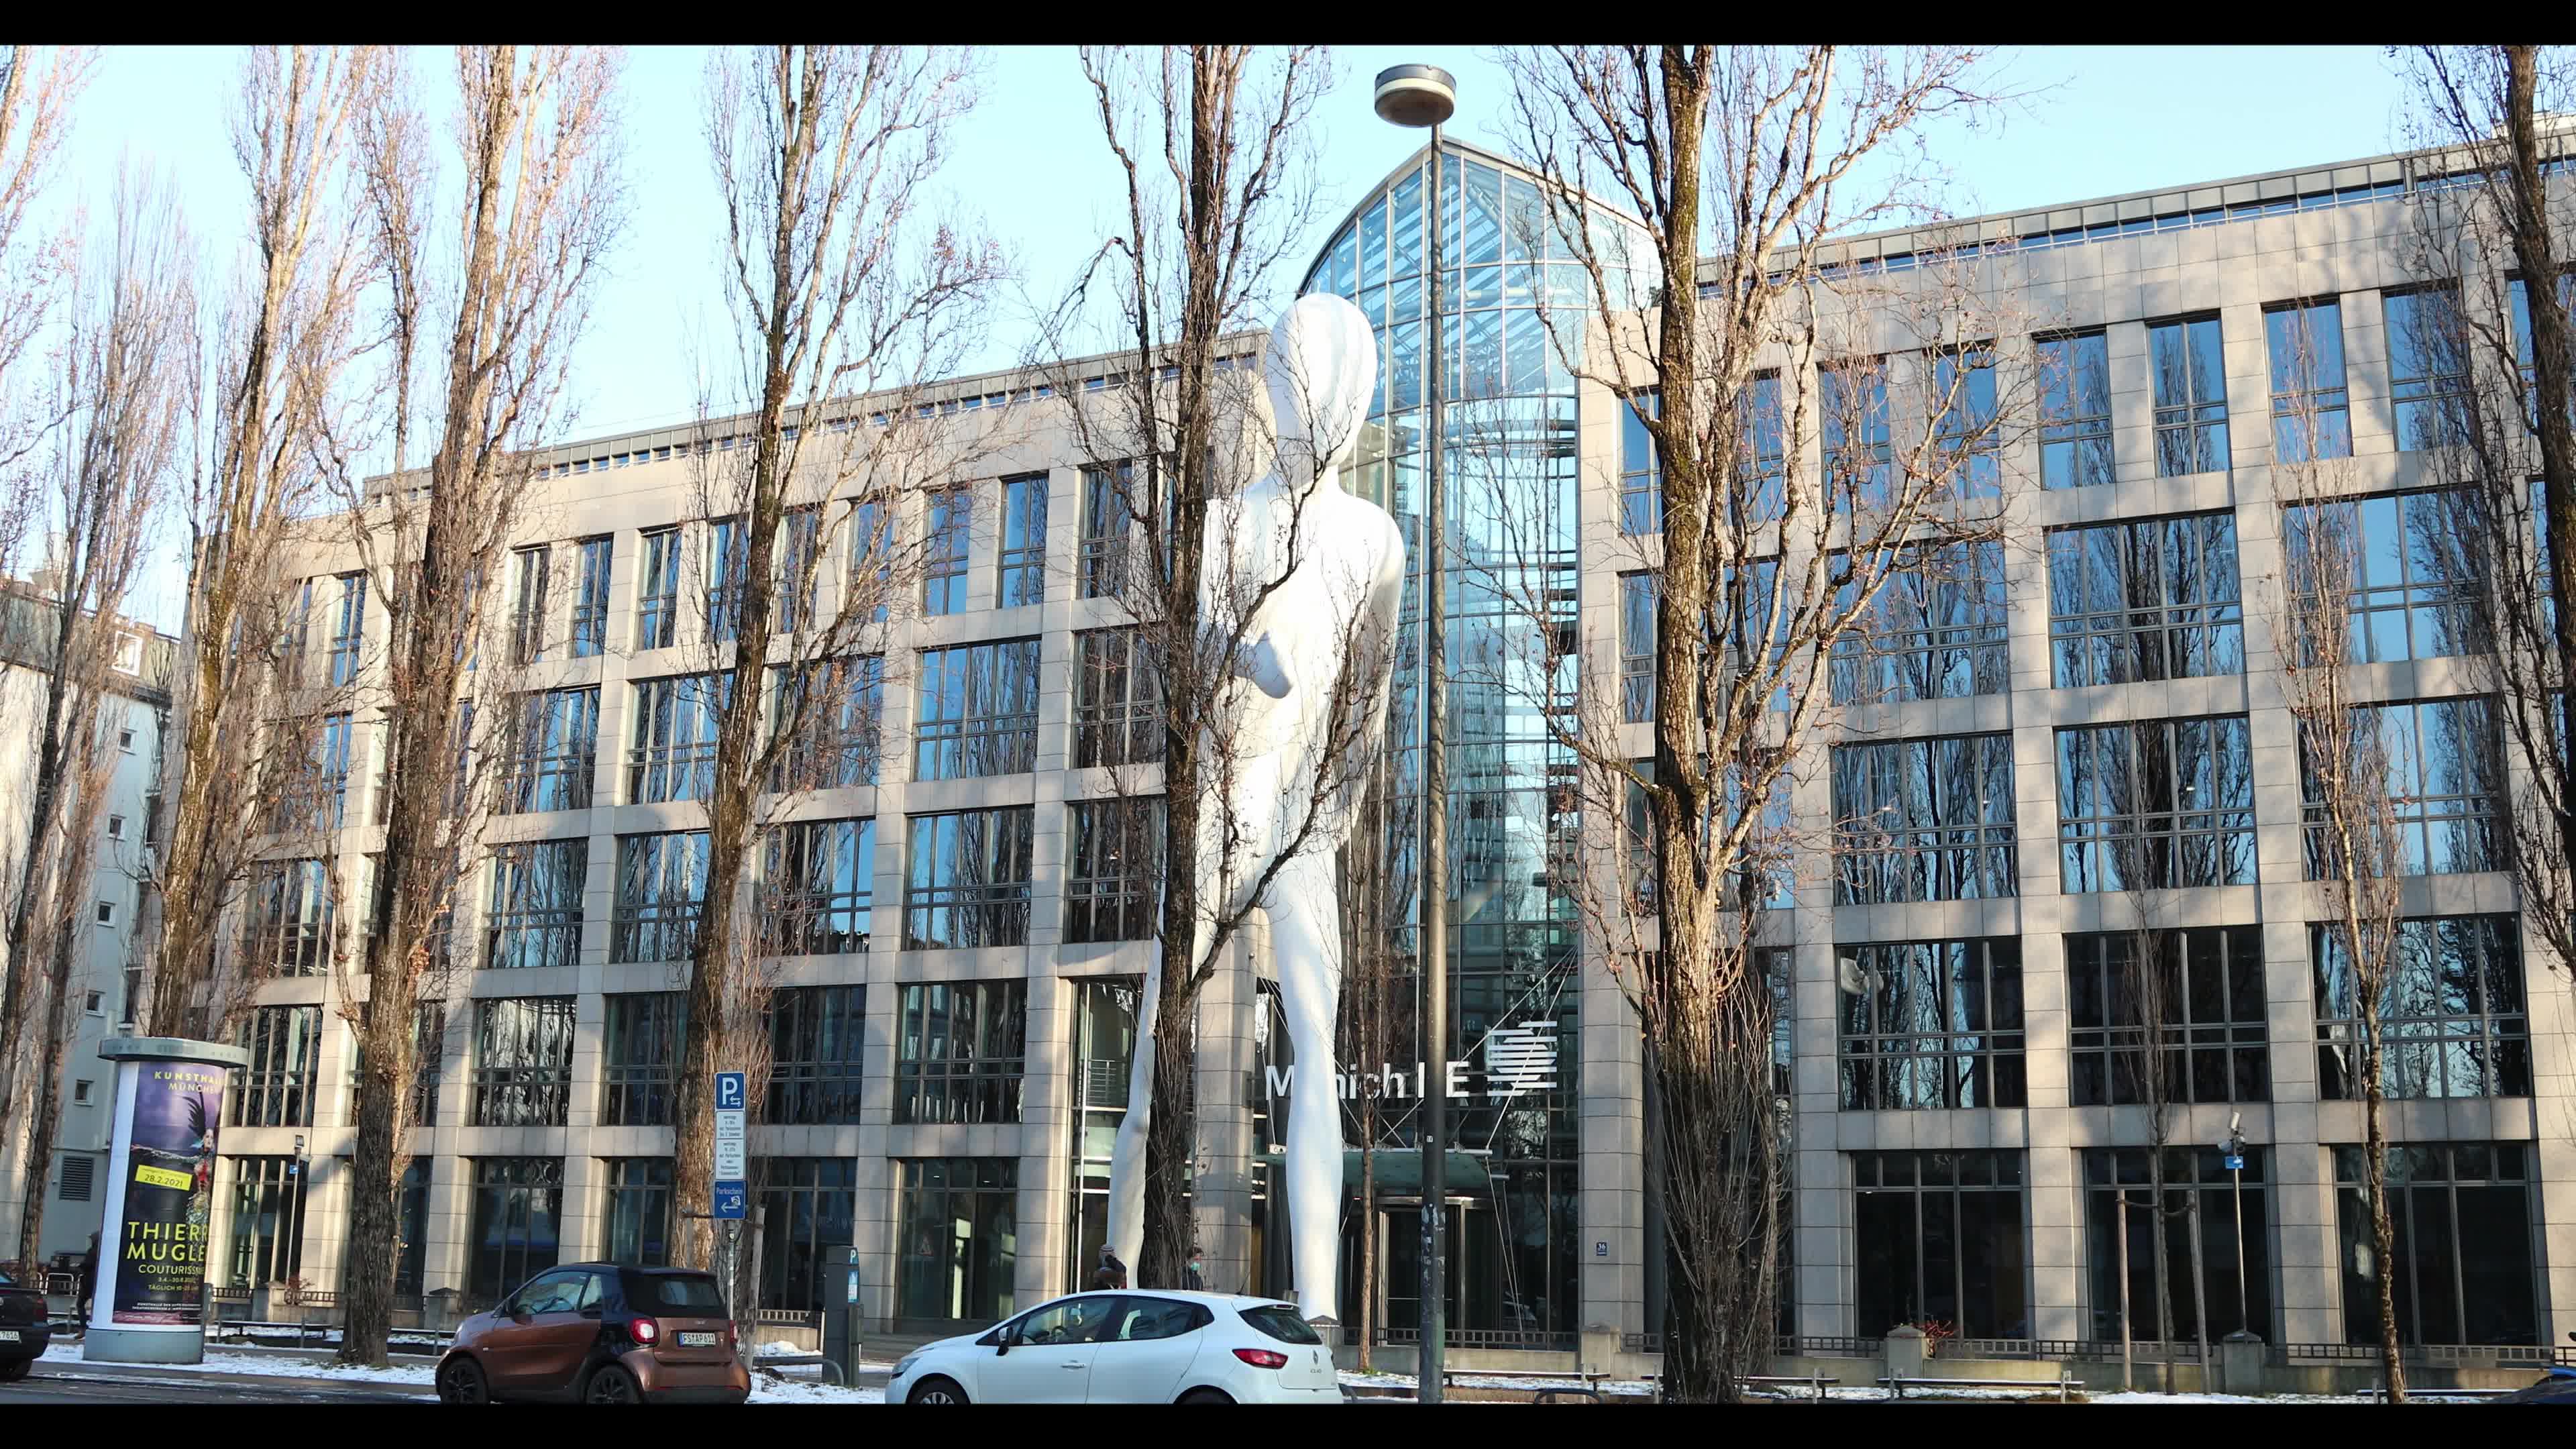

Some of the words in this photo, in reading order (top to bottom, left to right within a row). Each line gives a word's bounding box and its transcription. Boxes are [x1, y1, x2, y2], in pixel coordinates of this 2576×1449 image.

[722, 1077, 738, 1105] P
[1266, 1063, 1404, 1100] Mnich
[144, 1174, 182, 1187] 28.2.2021
[128, 1222, 208, 1242] THIERR
[127, 1242, 205, 1261] MUGLE
[850, 1249, 857, 1264] P
